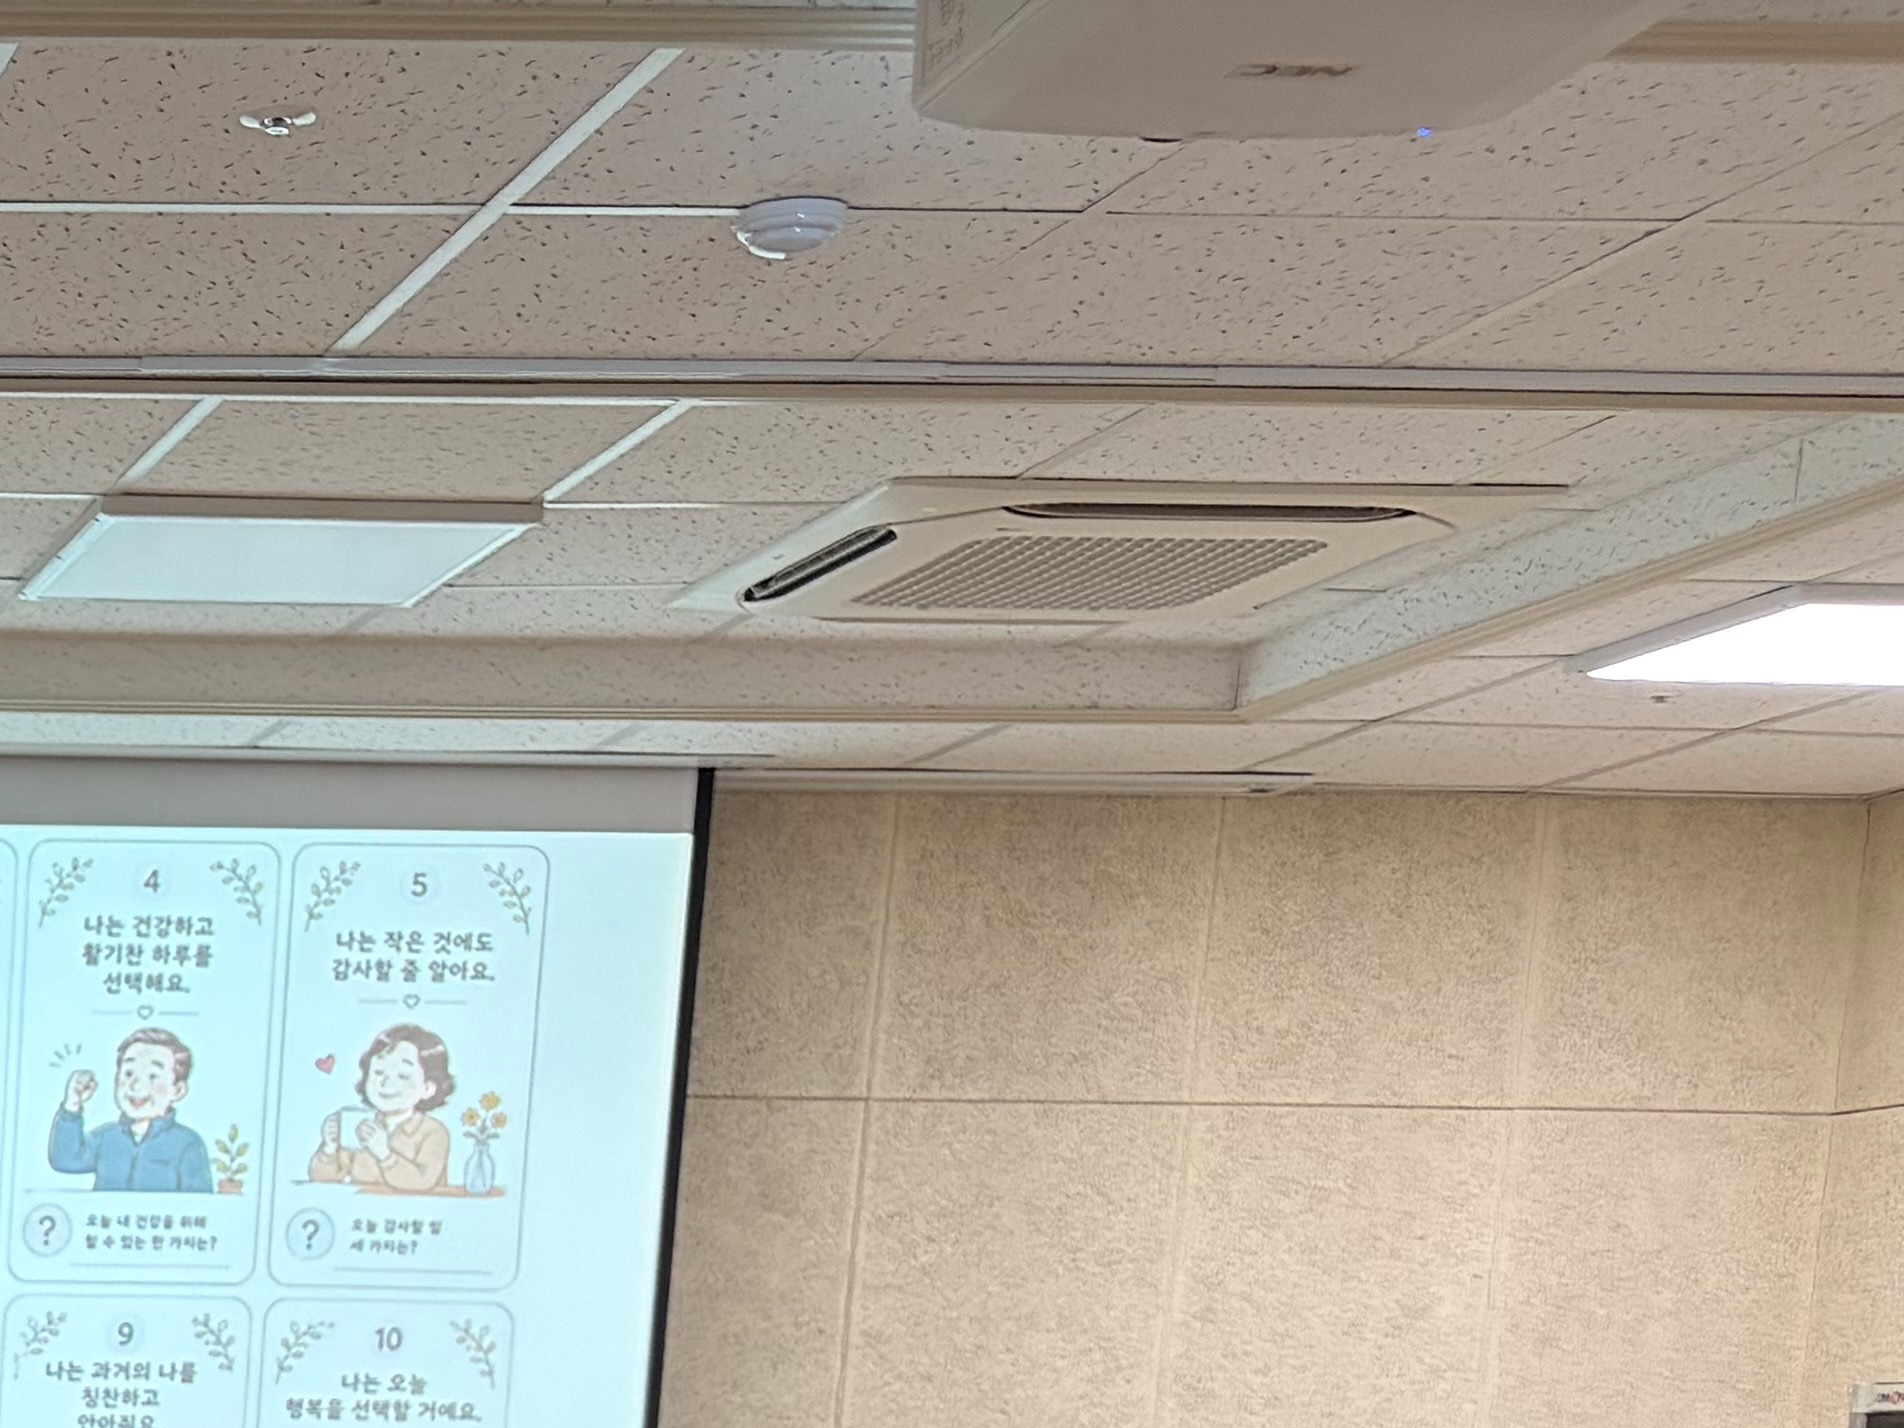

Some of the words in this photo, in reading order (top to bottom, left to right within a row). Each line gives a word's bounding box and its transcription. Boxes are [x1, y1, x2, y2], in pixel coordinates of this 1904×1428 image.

[143, 869, 160, 893] 4
[411, 872, 428, 897] 5
[84, 915, 124, 937] 나는
[132, 915, 214, 939] 건강하고
[336, 931, 376, 953] 나는
[384, 931, 425, 953] 작은
[433, 931, 494, 954] 것에도
[82, 942, 143, 966] 활기찬
[152, 944, 213, 968] 하루를
[333, 959, 393, 982] 감사할
[400, 959, 421, 983] 줄
[39, 1215, 56, 1246] ?
[302, 1219, 319, 1250] ?
[117, 1322, 134, 1346] 9
[375, 1327, 403, 1351] 10
[46, 1361, 84, 1382] 나는
[91, 1361, 151, 1381] 과거의
[159, 1361, 197, 1384] 나를
[341, 1372, 381, 1394] 나는
[387, 1373, 427, 1396] 오늘
[82, 1387, 160, 1409] 칭찬하고
[286, 1398, 345, 1420] 행복을
[351, 1399, 412, 1422] 선택할
